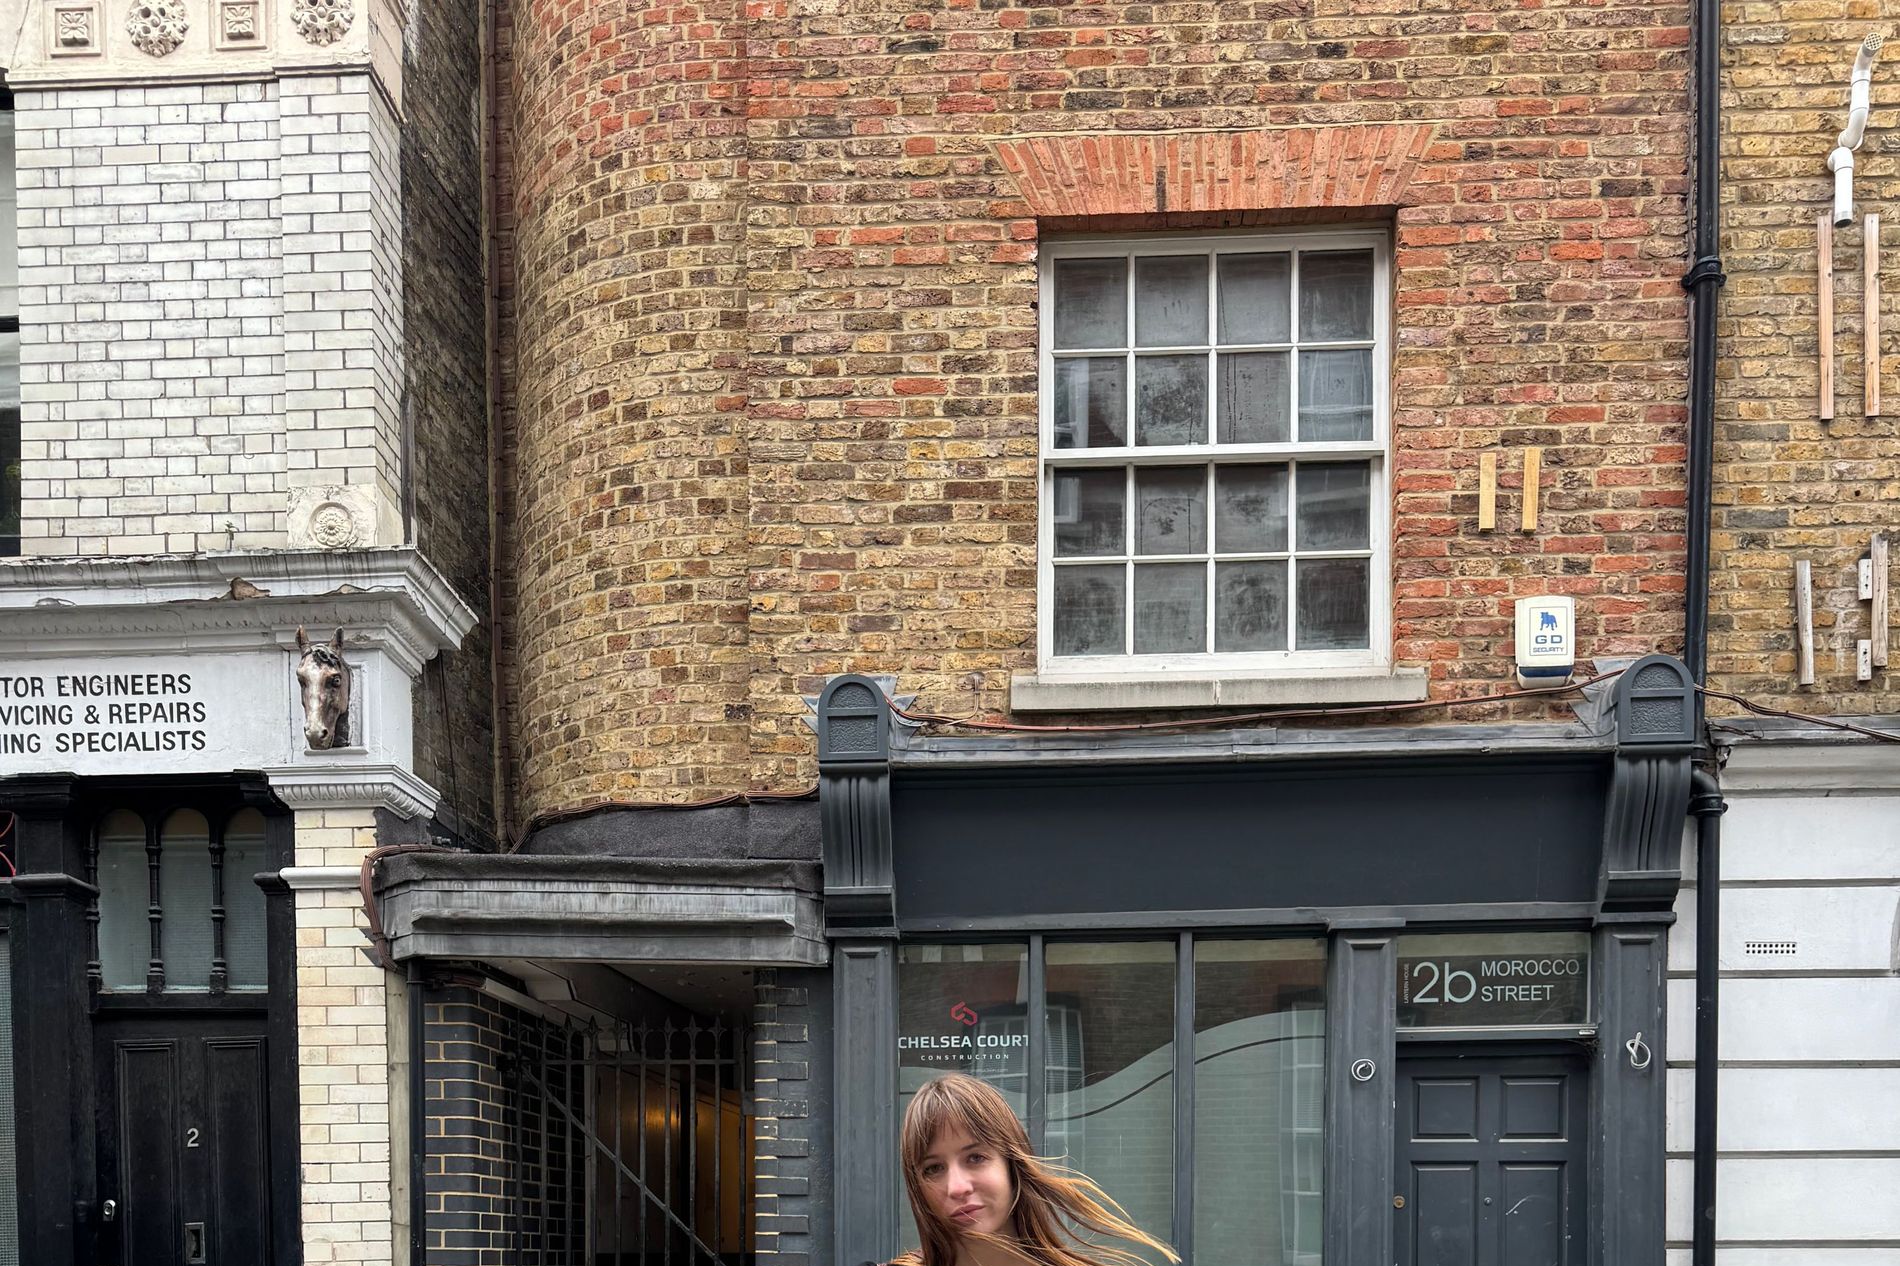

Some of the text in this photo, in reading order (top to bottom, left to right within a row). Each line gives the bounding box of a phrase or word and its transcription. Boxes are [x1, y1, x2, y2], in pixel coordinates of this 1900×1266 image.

[0, 673, 191, 698] TOR ENGINEERS
[0, 701, 206, 726] VICING & REPAIRS
[0, 730, 206, 754] ING SPECIALISTS
[1481, 959, 1580, 977] MOROCCO
[1413, 961, 1477, 1003] 2b
[1481, 985, 1555, 1002] STREET
[897, 1034, 1029, 1049] CHELSEA COURT
[187, 1127, 199, 1148] 2
